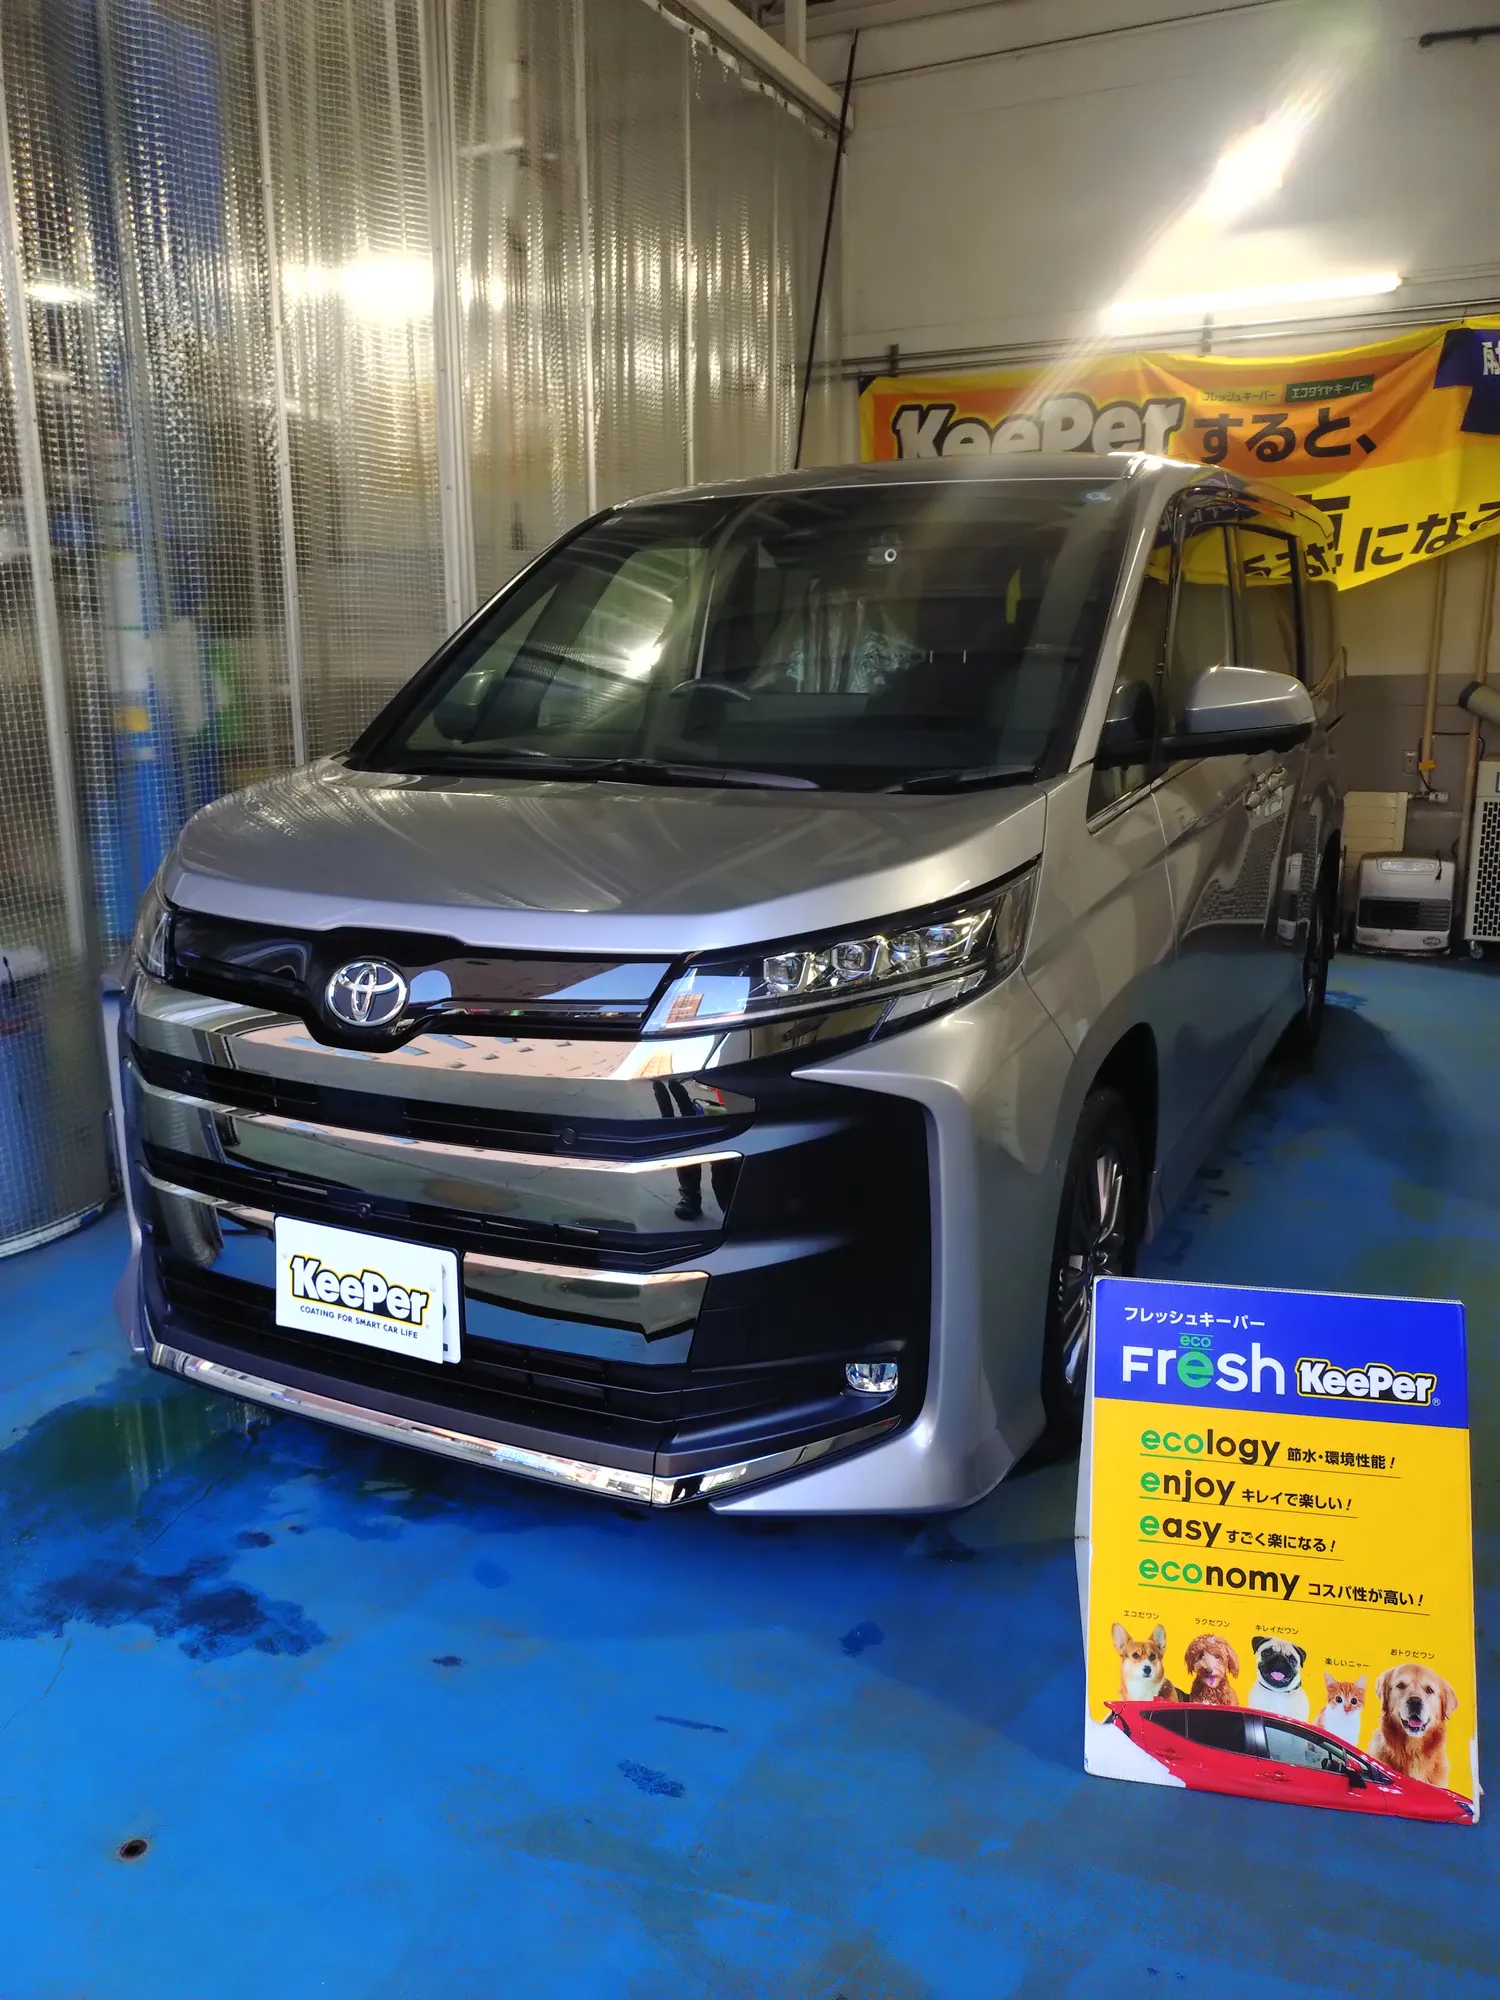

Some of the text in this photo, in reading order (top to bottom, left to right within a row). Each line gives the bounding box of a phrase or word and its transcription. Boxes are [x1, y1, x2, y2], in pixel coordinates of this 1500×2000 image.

[1291, 380, 1368, 399] エコダイヤキーパー
[892, 390, 1187, 459] KeePer
[1194, 407, 1377, 465] すると、
[290, 1254, 430, 1326] KeePer
[299, 1305, 418, 1339] COATING FOR SMART CAR LIFE
[1123, 1307, 1266, 1330] フレッシュキーパー
[1179, 1335, 1211, 1348] eco
[1122, 1343, 1437, 1405] Fresh KeePer
[1140, 1429, 1280, 1466] ecology
[1140, 1469, 1353, 1512] enjoy キレイで楽しい！
[1139, 1515, 1336, 1553] easy すごく楽になる！
[1138, 1558, 1424, 1607] economy コスパ性が高い！
[1123, 1609, 1160, 1620] エコだワン
[1194, 1617, 1231, 1628] ラクだワン
[1255, 1623, 1299, 1636] キレイだワン
[1324, 1657, 1370, 1669] 楽しいニャー
[1390, 1648, 1436, 1660] おトクだワン
